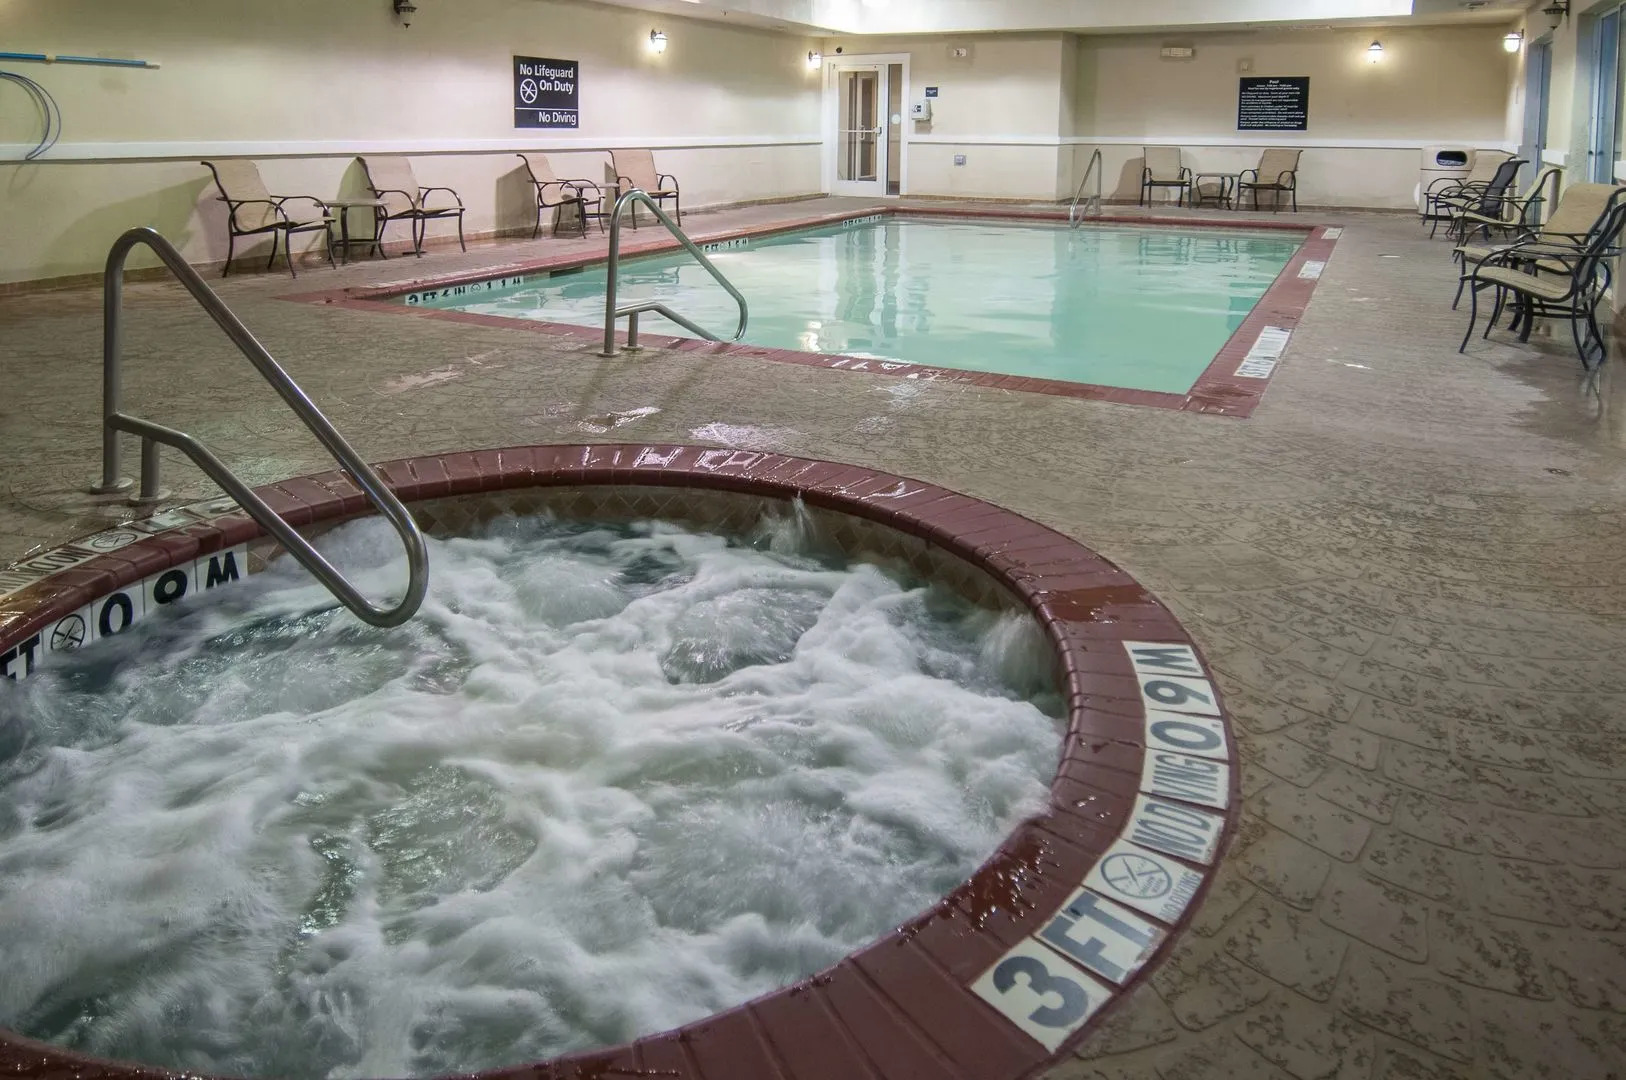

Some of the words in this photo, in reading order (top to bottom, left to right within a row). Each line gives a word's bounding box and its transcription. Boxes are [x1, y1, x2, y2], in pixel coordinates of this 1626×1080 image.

[520, 64, 532, 75] No
[534, 65, 574, 80] Lifeguard
[540, 80, 553, 91] On
[554, 80, 574, 95] Duty
[539, 111, 551, 123] No
[552, 112, 577, 126] Diving
[1130, 648, 1201, 673] M
[1039, 890, 1160, 986] FT
[992, 955, 1090, 1029] 3
